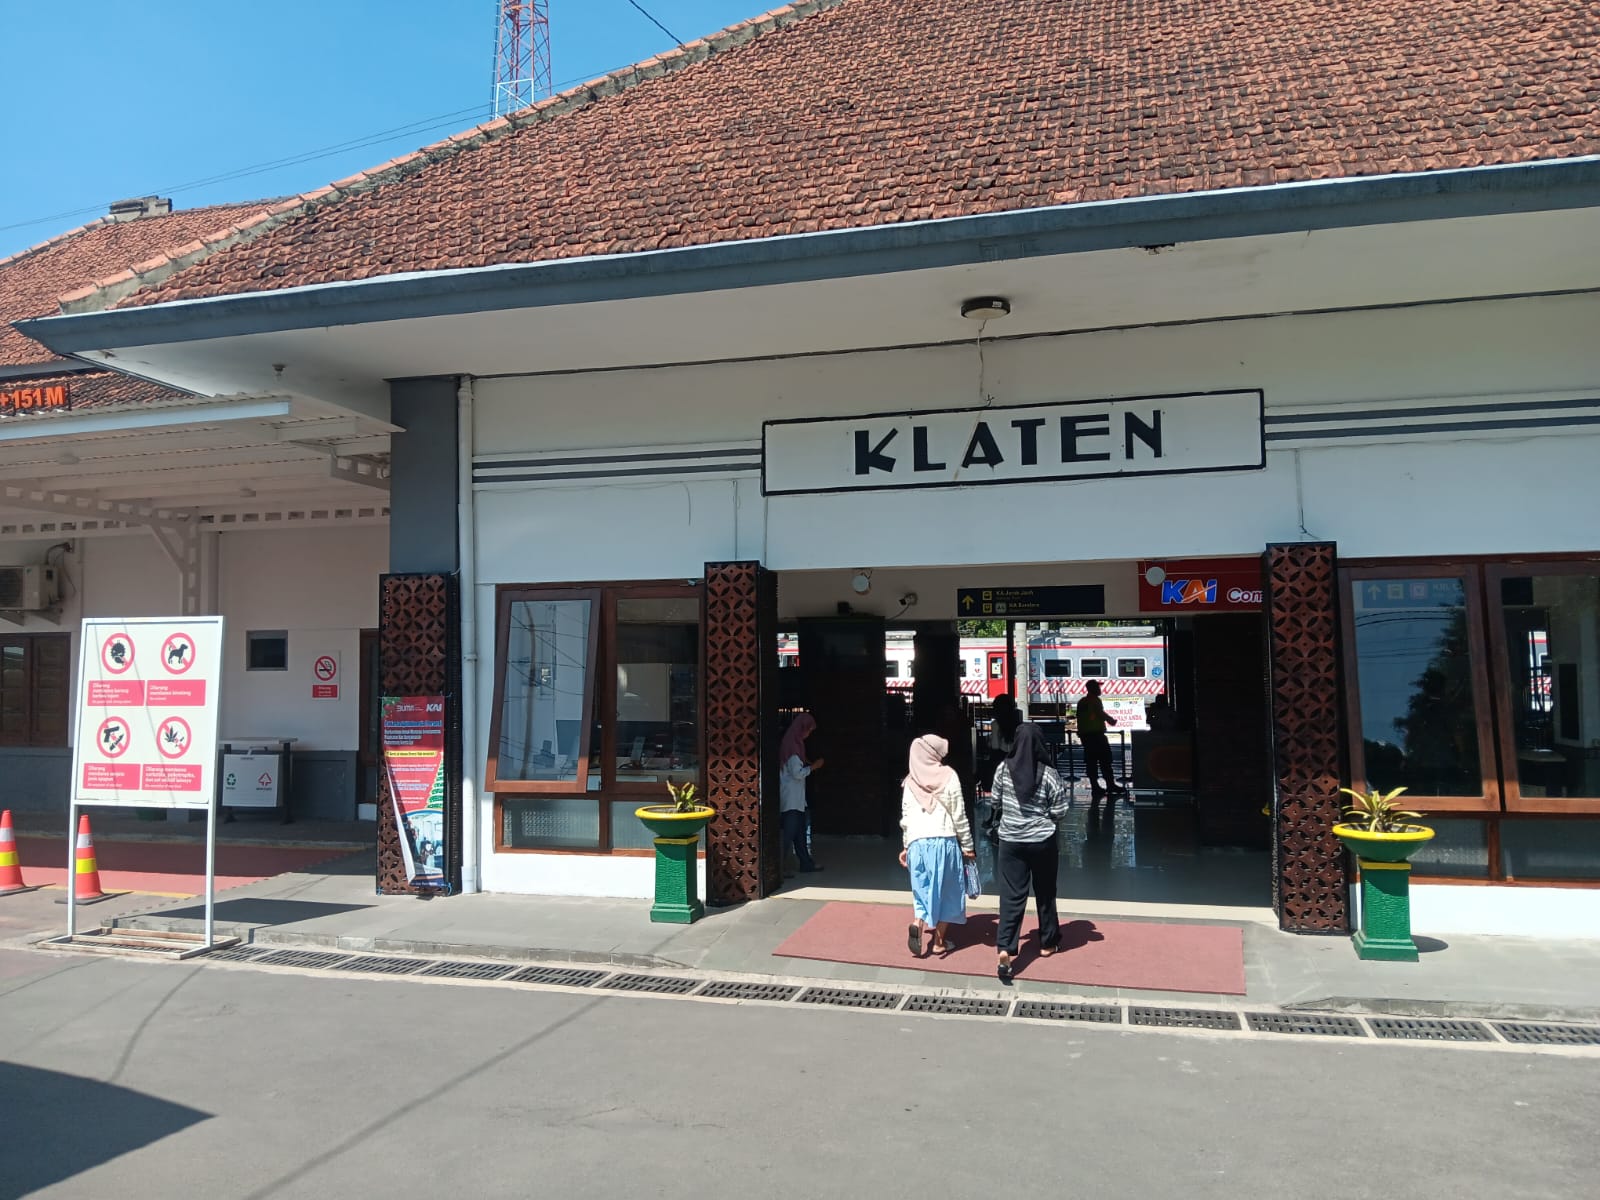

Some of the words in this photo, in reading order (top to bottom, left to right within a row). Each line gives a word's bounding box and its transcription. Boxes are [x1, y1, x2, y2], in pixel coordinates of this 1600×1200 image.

[46, 386, 65, 407] M
[854, 410, 1162, 475] KLATEN
[1161, 578, 1218, 604] KAI
[426, 703, 443, 712] KAI
